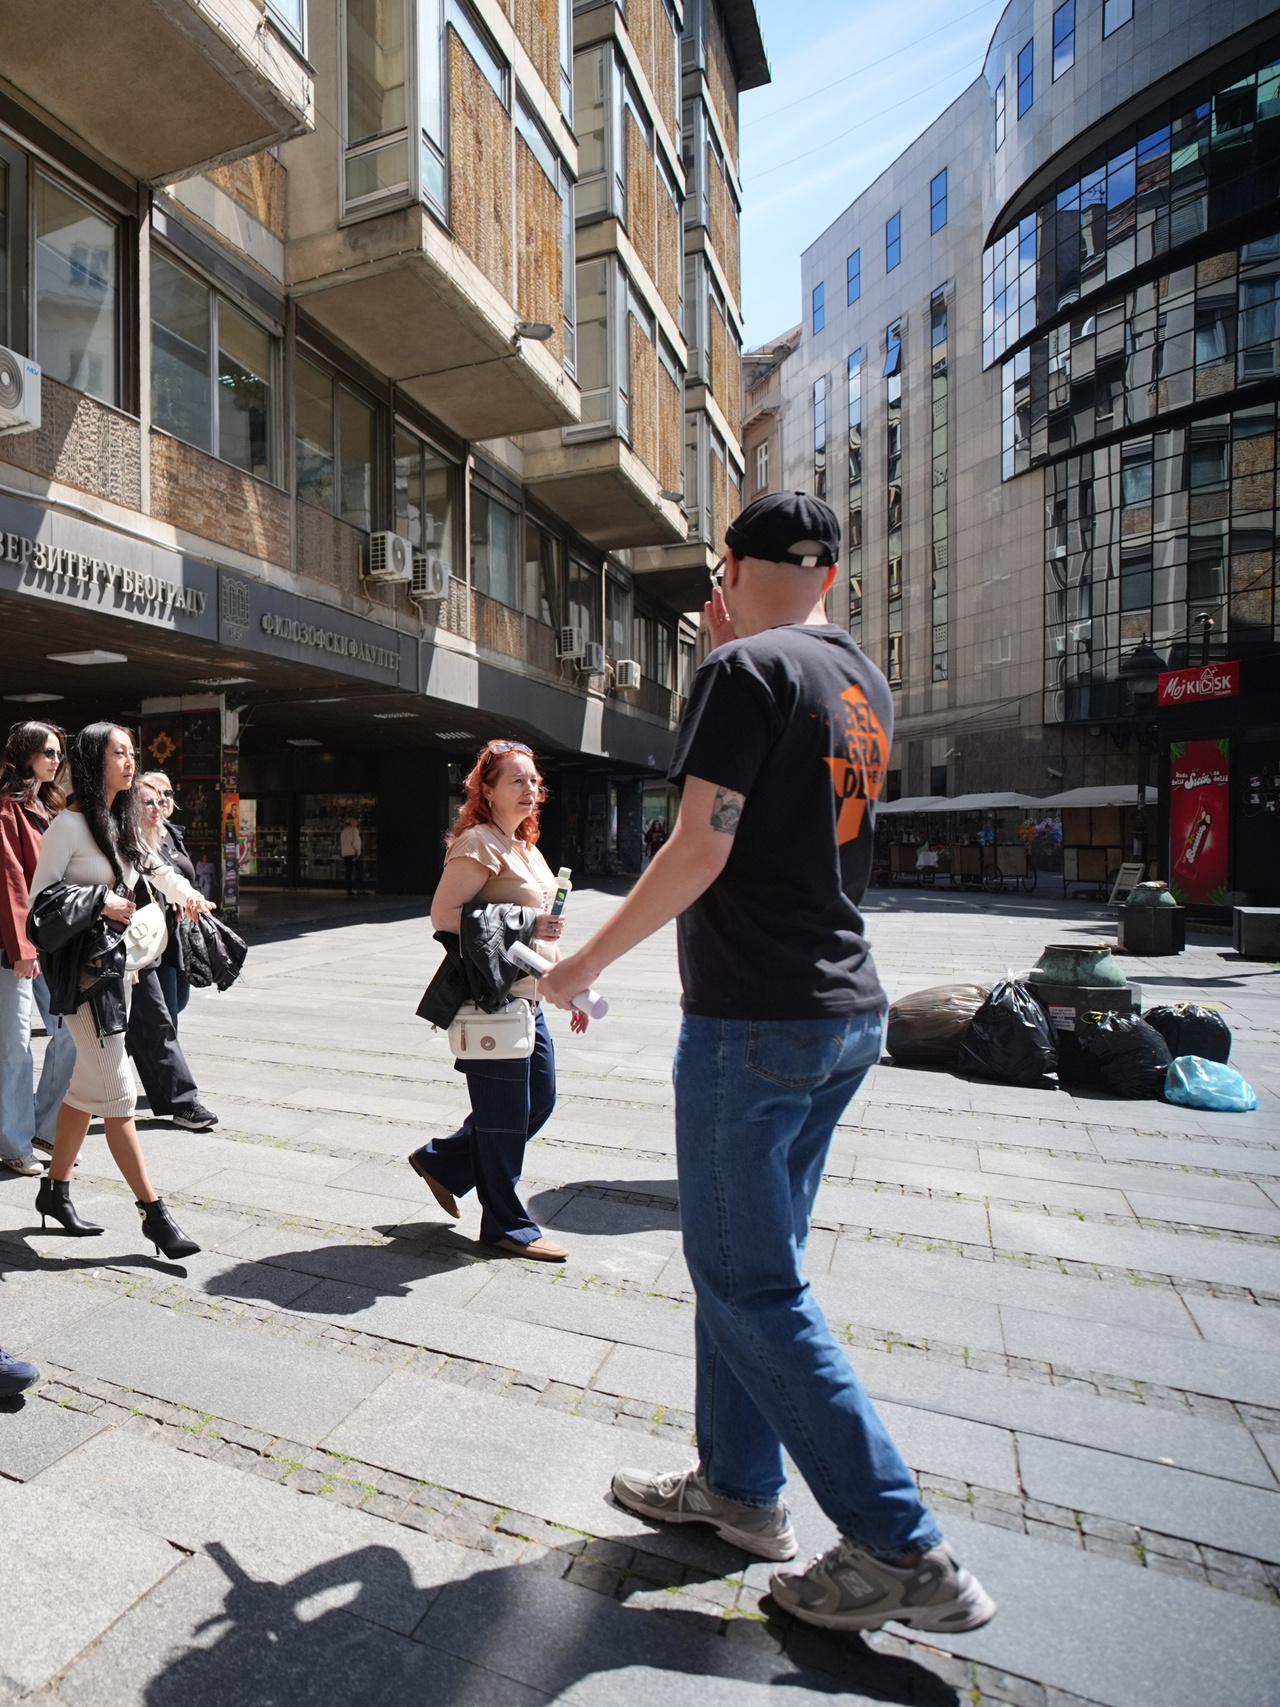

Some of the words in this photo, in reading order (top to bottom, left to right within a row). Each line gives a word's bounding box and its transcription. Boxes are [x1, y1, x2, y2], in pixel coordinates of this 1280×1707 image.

[103, 562, 118, 589] У
[120, 567, 209, 617] БЕОГРАДУ
[261, 612, 348, 655] ФИЛОЗОФСКИ
[349, 639, 401, 671] ФАКУЛТЕТ
